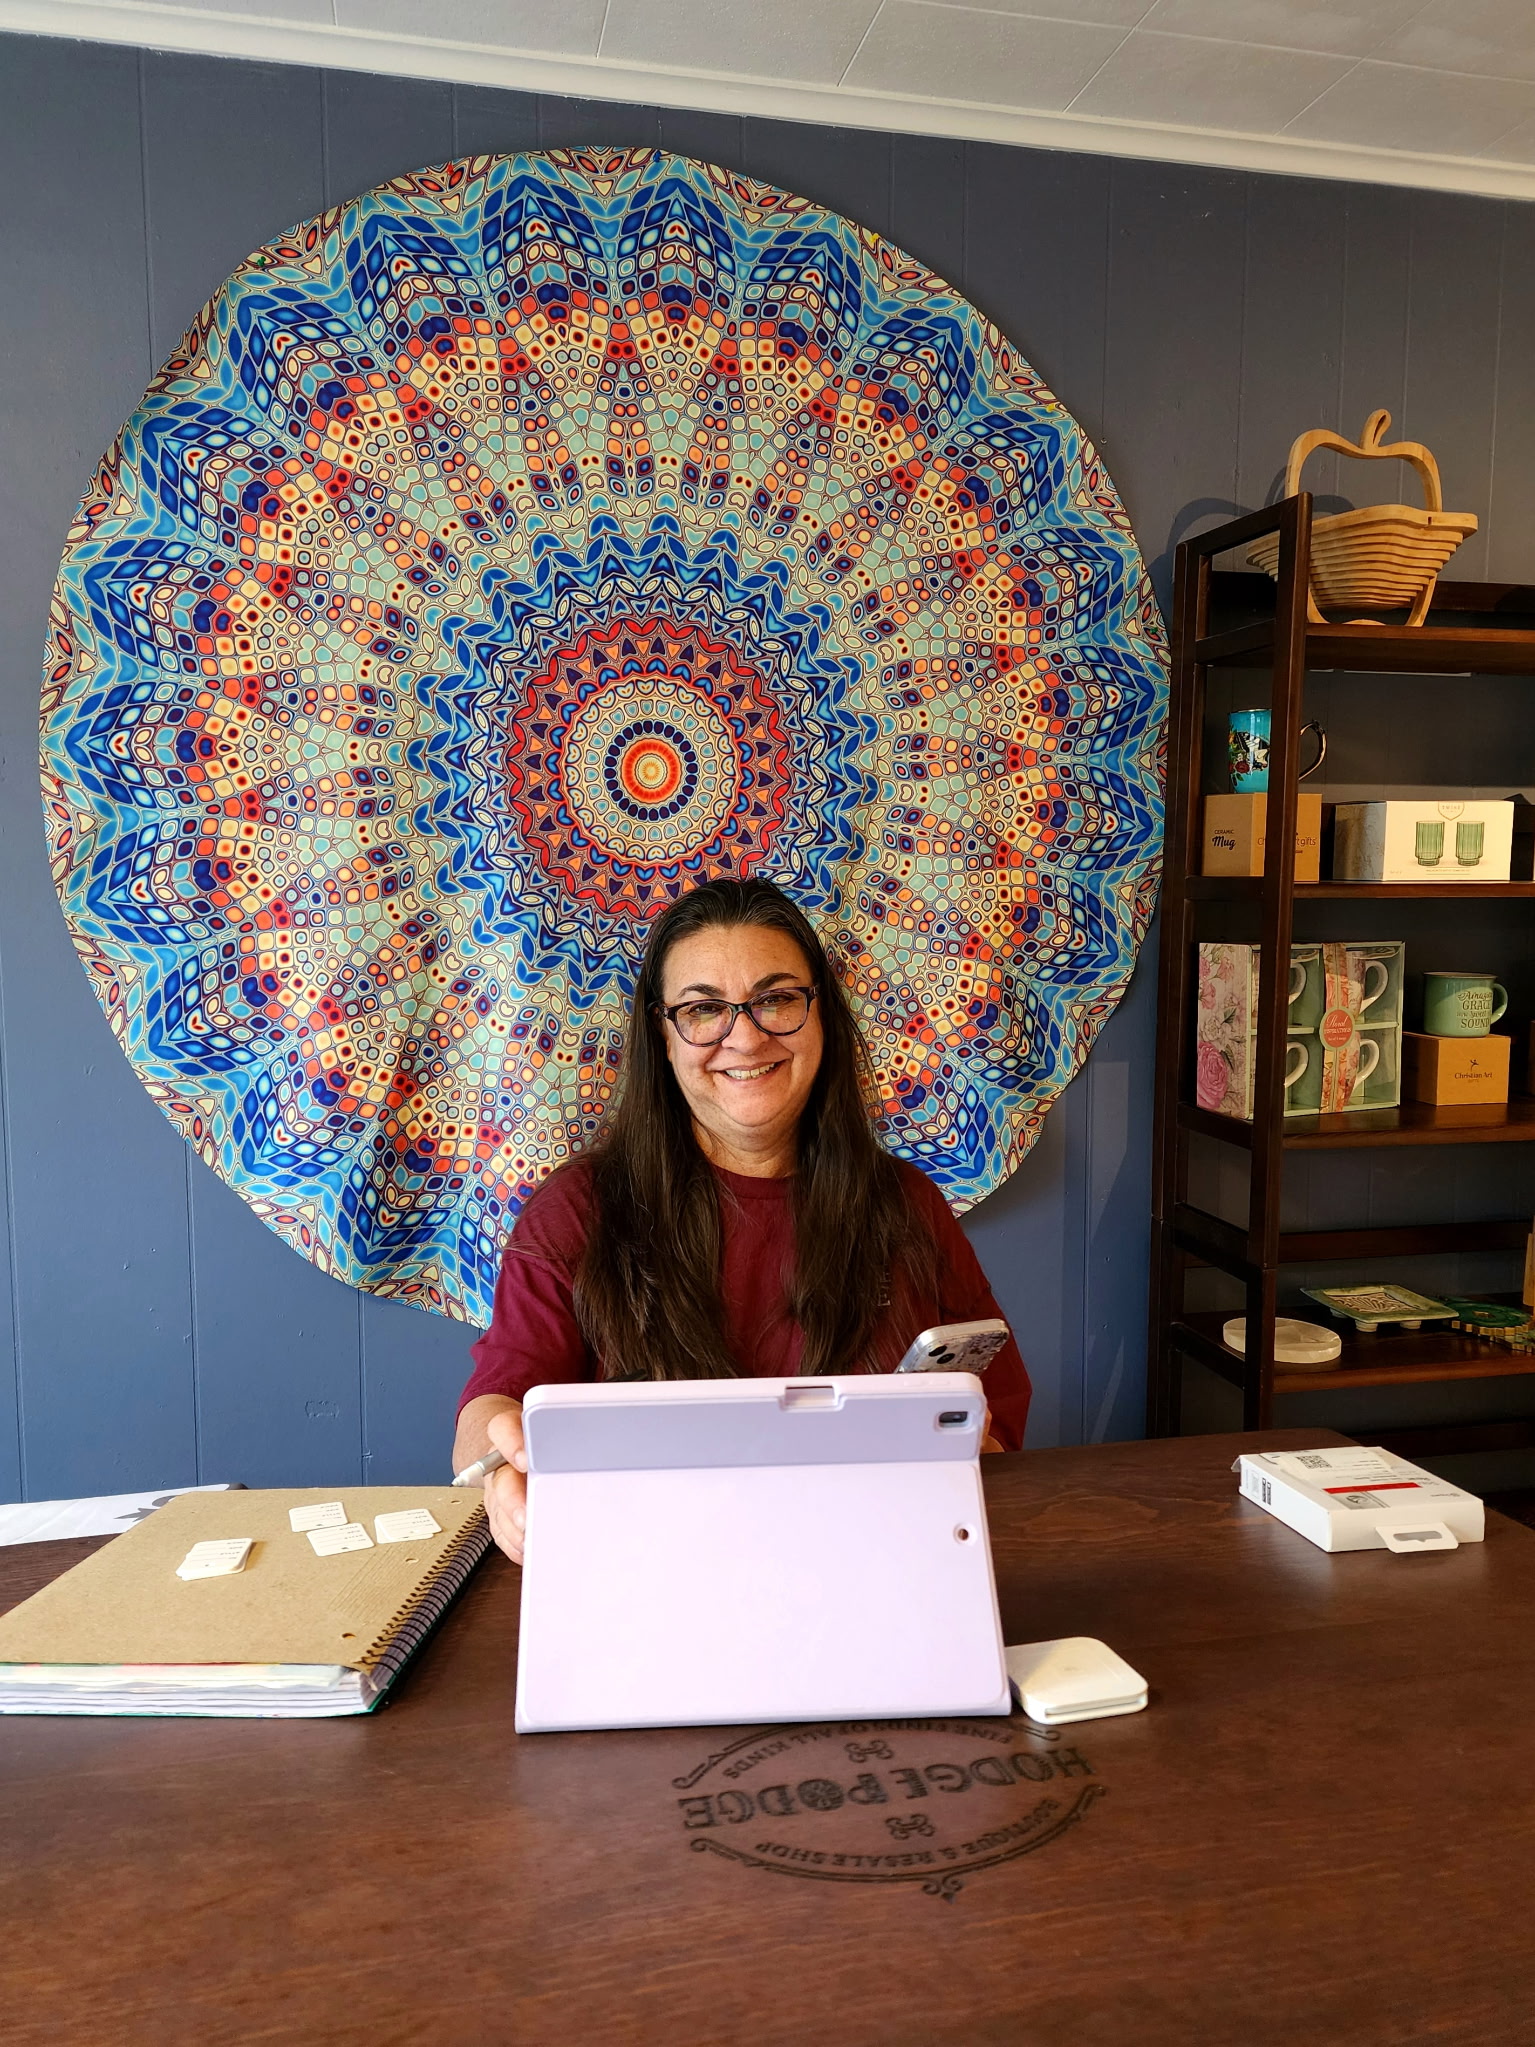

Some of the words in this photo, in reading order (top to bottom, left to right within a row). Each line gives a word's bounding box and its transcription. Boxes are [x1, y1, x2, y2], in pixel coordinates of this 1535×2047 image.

[1211, 836, 1236, 850] Mug
[1457, 990, 1492, 1001] Amaz
[1462, 1000, 1490, 1011] GRACE
[790, 1728, 832, 1744] ALL
[955, 1725, 1013, 1744] FINE
[722, 1741, 793, 1779] KINDS
[889, 1748, 1096, 1800] HODGE
[960, 1799, 1061, 1856] BOUTIQUE
[755, 1842, 827, 1864] SHOP
[831, 1852, 936, 1868] RESALE
[937, 1846, 959, 1860] &
